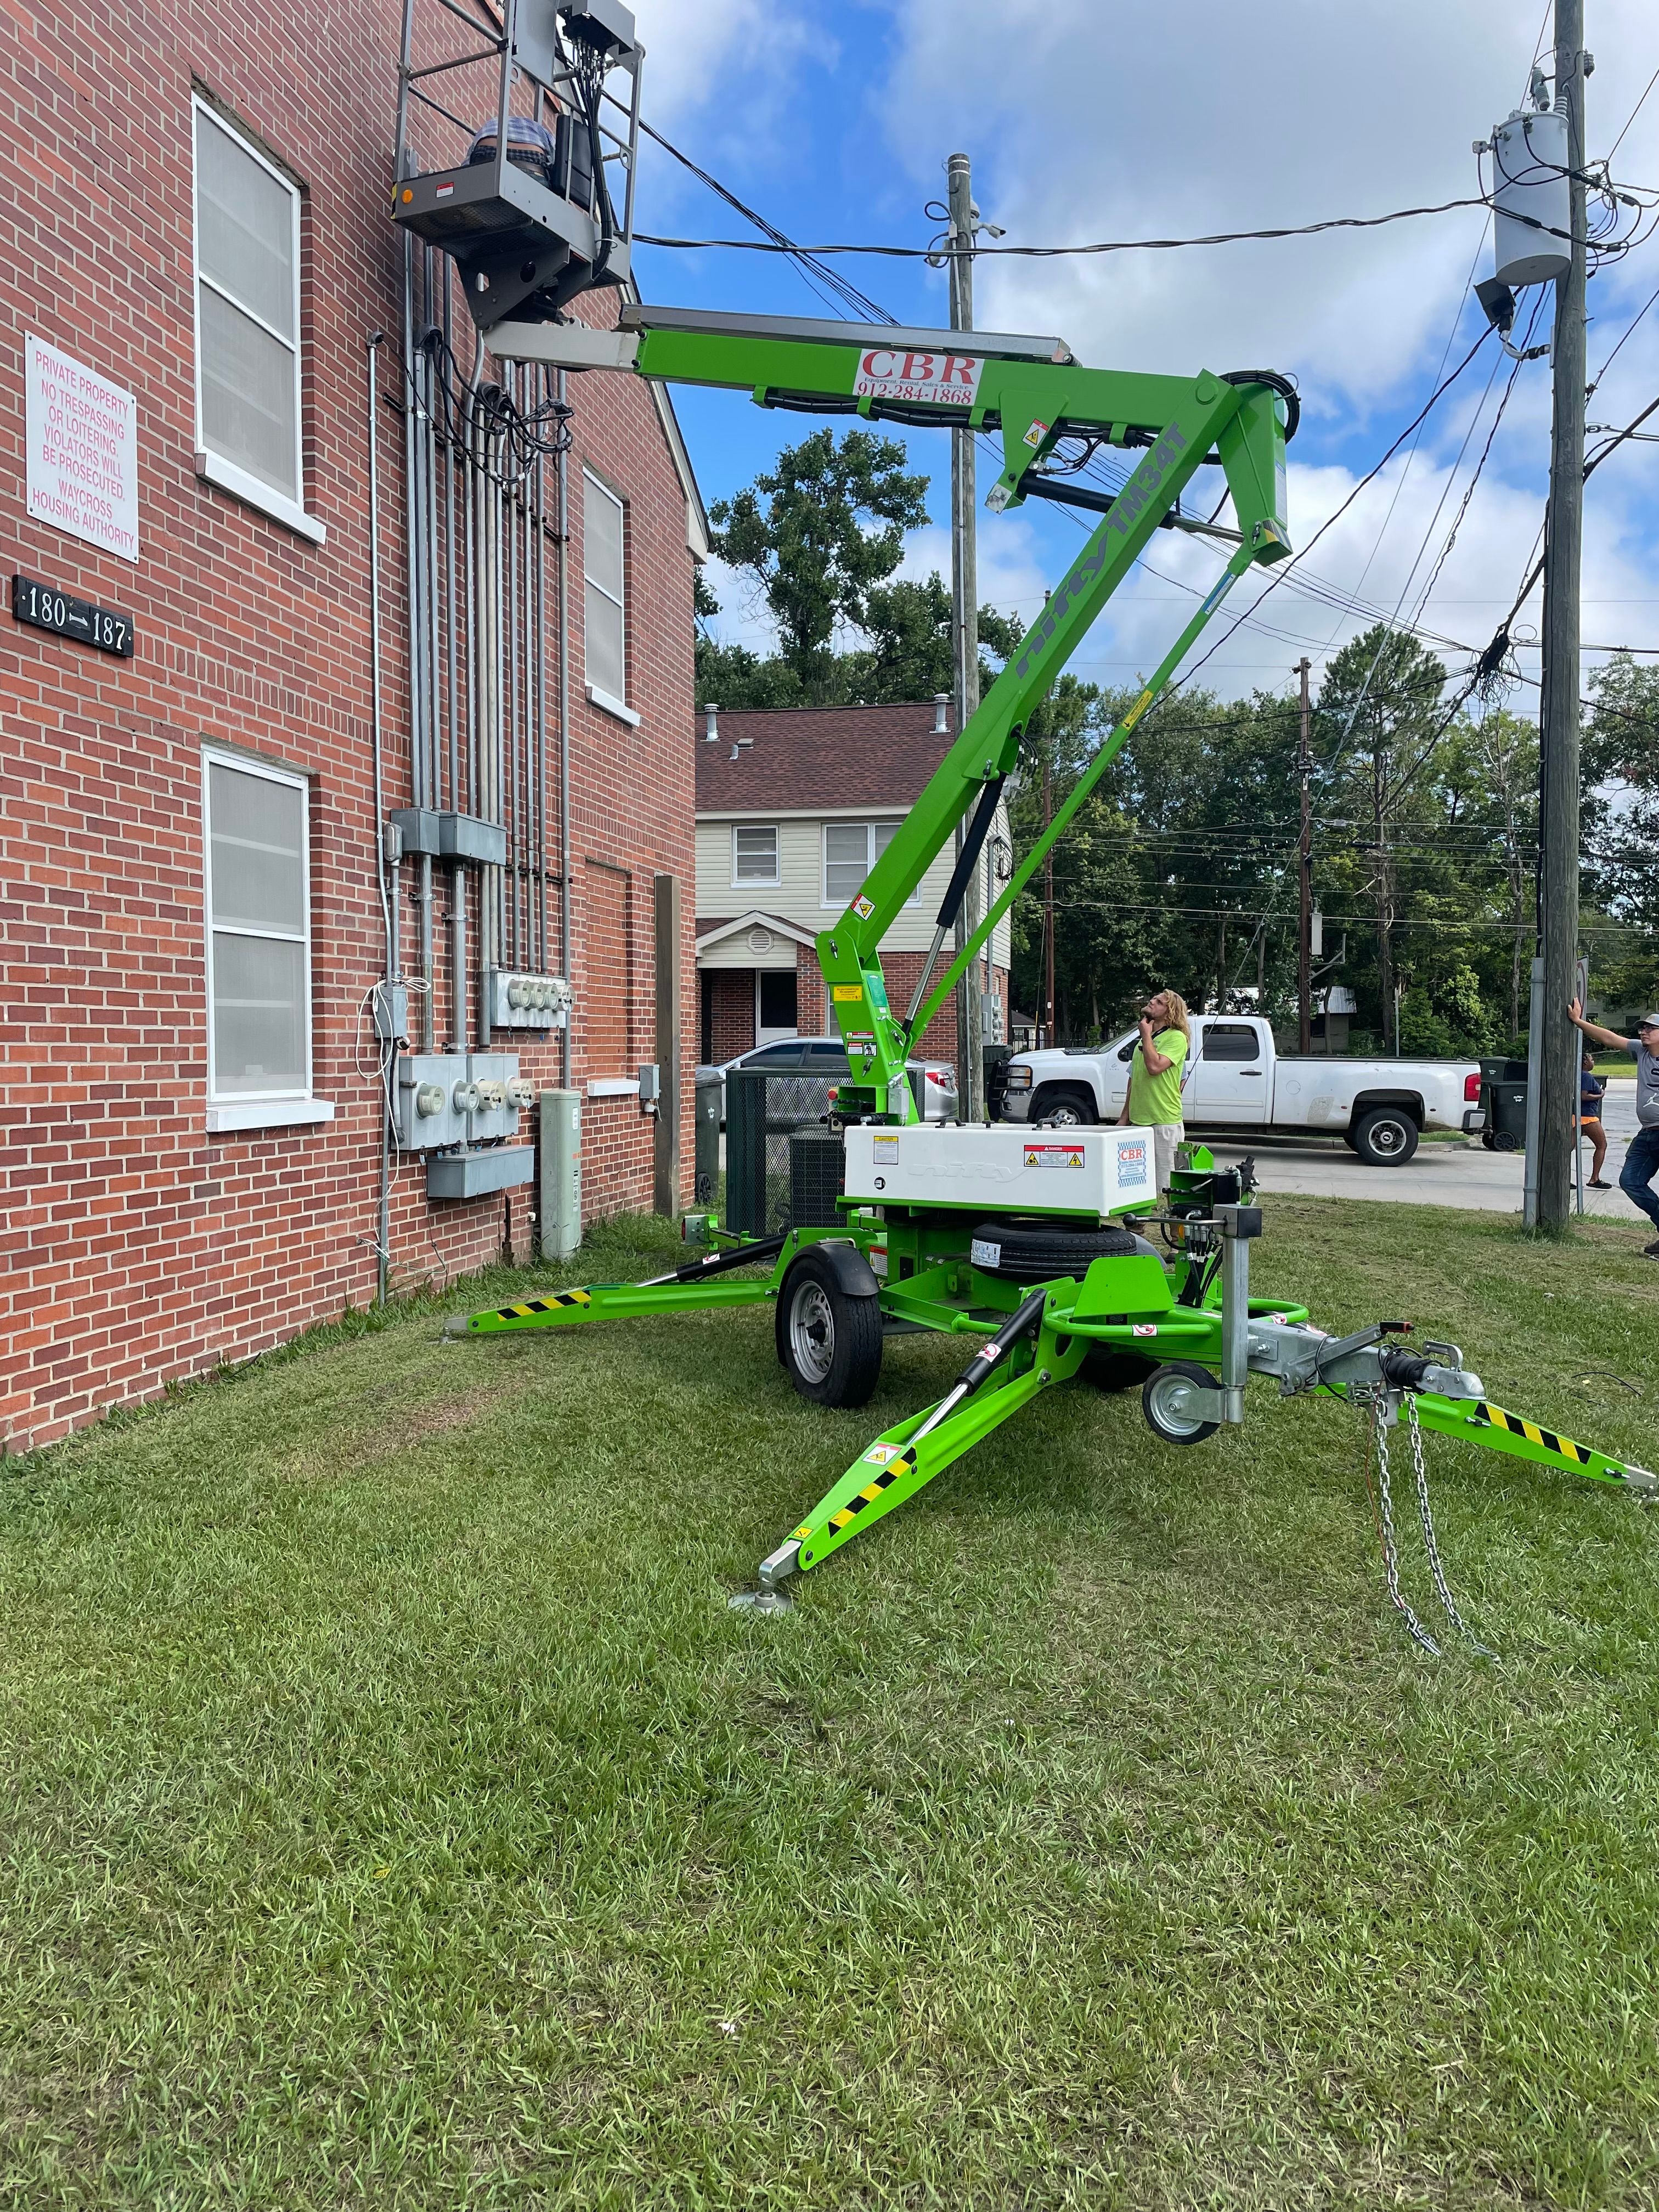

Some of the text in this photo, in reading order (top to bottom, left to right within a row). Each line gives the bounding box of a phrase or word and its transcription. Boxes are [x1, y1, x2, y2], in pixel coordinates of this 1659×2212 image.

[36, 351, 128, 419] PRIVATE PROPERTY
[857, 382, 972, 404] 912-284-1868
[862, 351, 975, 385] CBR
[42, 379, 125, 440] NO TRESPASSING
[49, 405, 119, 458] OR LOITERING.
[43, 444, 125, 501] BE PROSECUTED.
[44, 424, 123, 480] VIOLATORS WILL
[33, 487, 134, 549] HOUSING AUTHORITY
[58, 478, 112, 520] WAYCROSS
[1015, 421, 1187, 679] nifty TM34T
[908, 1161, 1030, 1183] nifty
[1121, 1149, 1143, 1160] CBR
